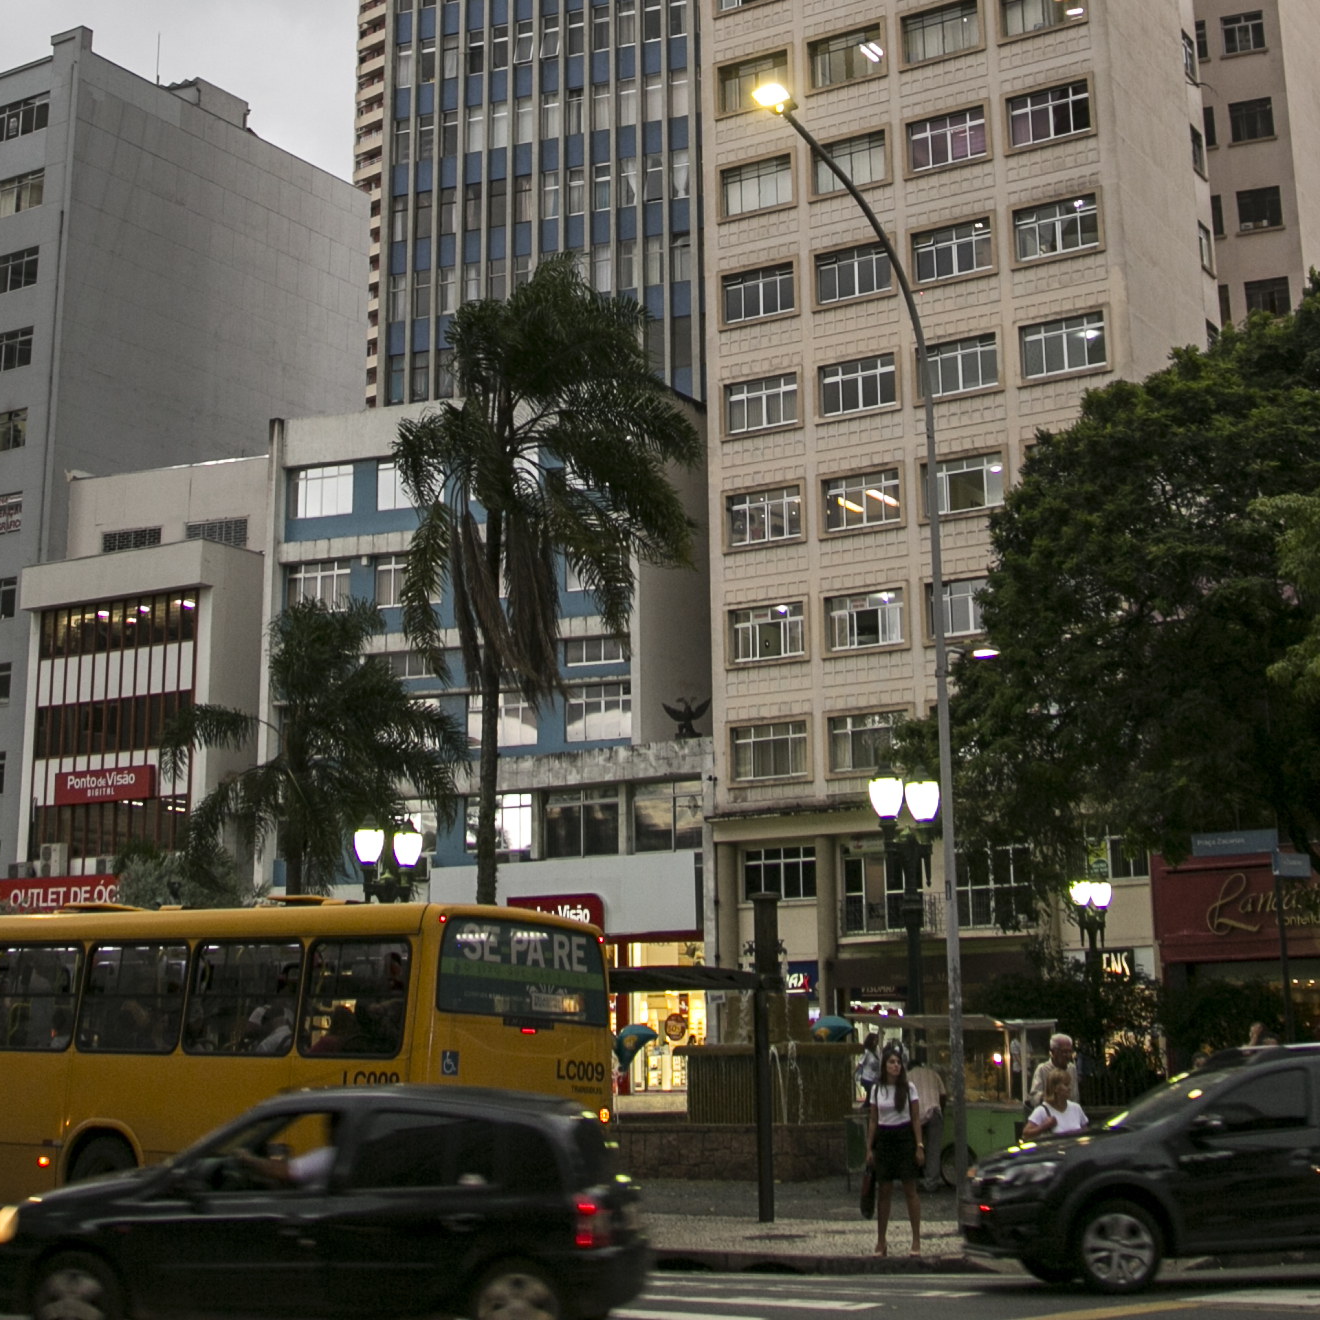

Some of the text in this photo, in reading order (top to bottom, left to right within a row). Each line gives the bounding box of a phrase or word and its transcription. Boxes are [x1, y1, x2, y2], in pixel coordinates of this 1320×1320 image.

[67, 770, 136, 790] Ponto de Visão
[87, 787, 115, 797] DIGITAL
[10, 886, 67, 907] OUTLET
[69, 886, 91, 905] DE
[557, 904, 591, 923] Visão
[556, 1059, 606, 1084] LC009
[571, 1085, 603, 1096] TRANSBUS
